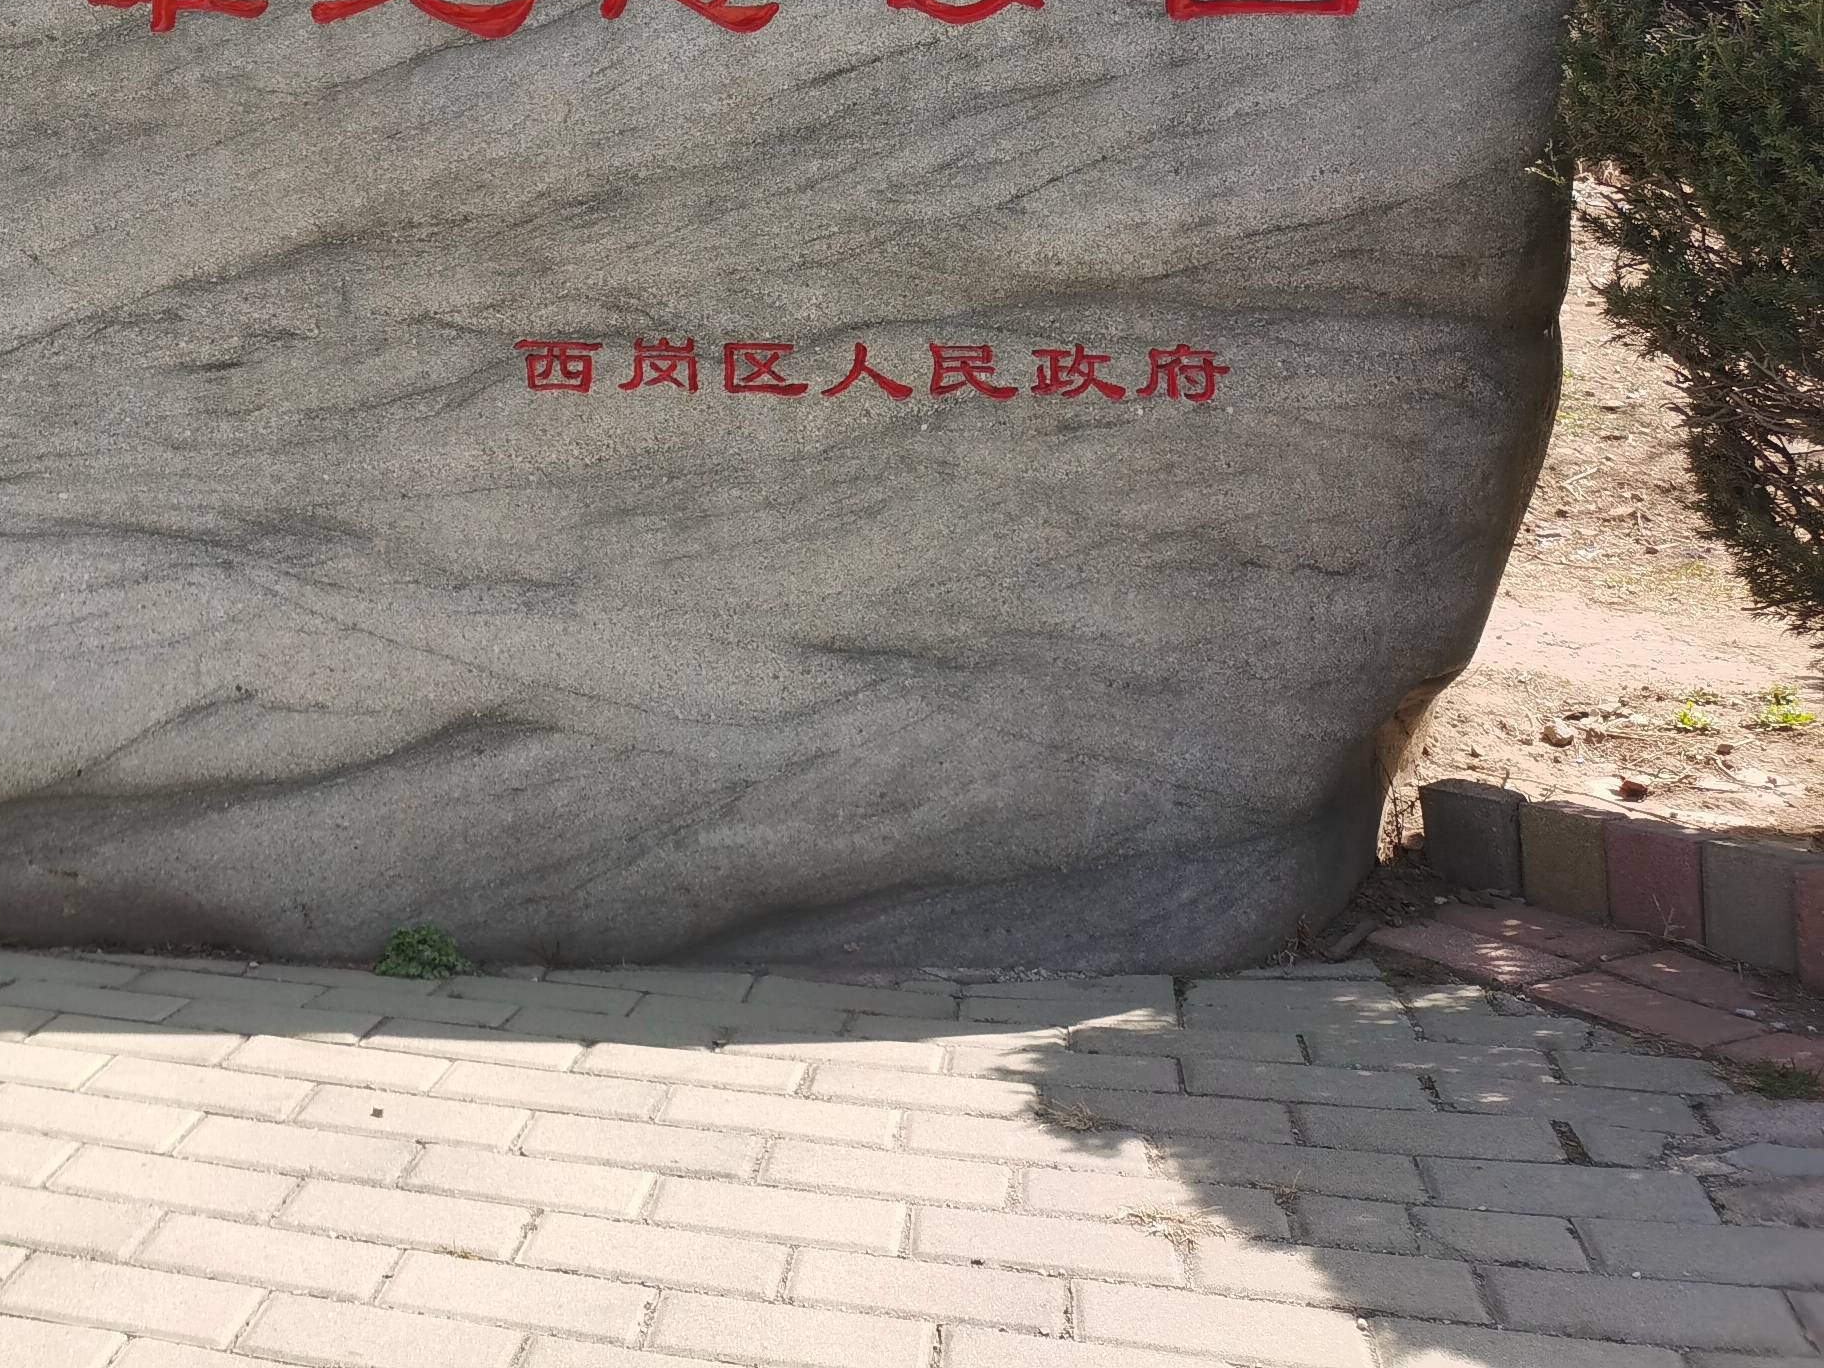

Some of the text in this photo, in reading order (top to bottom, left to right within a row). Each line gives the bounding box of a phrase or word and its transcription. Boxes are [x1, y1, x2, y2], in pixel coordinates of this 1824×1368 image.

[514, 337, 1230, 403] 西岗区人民政府
